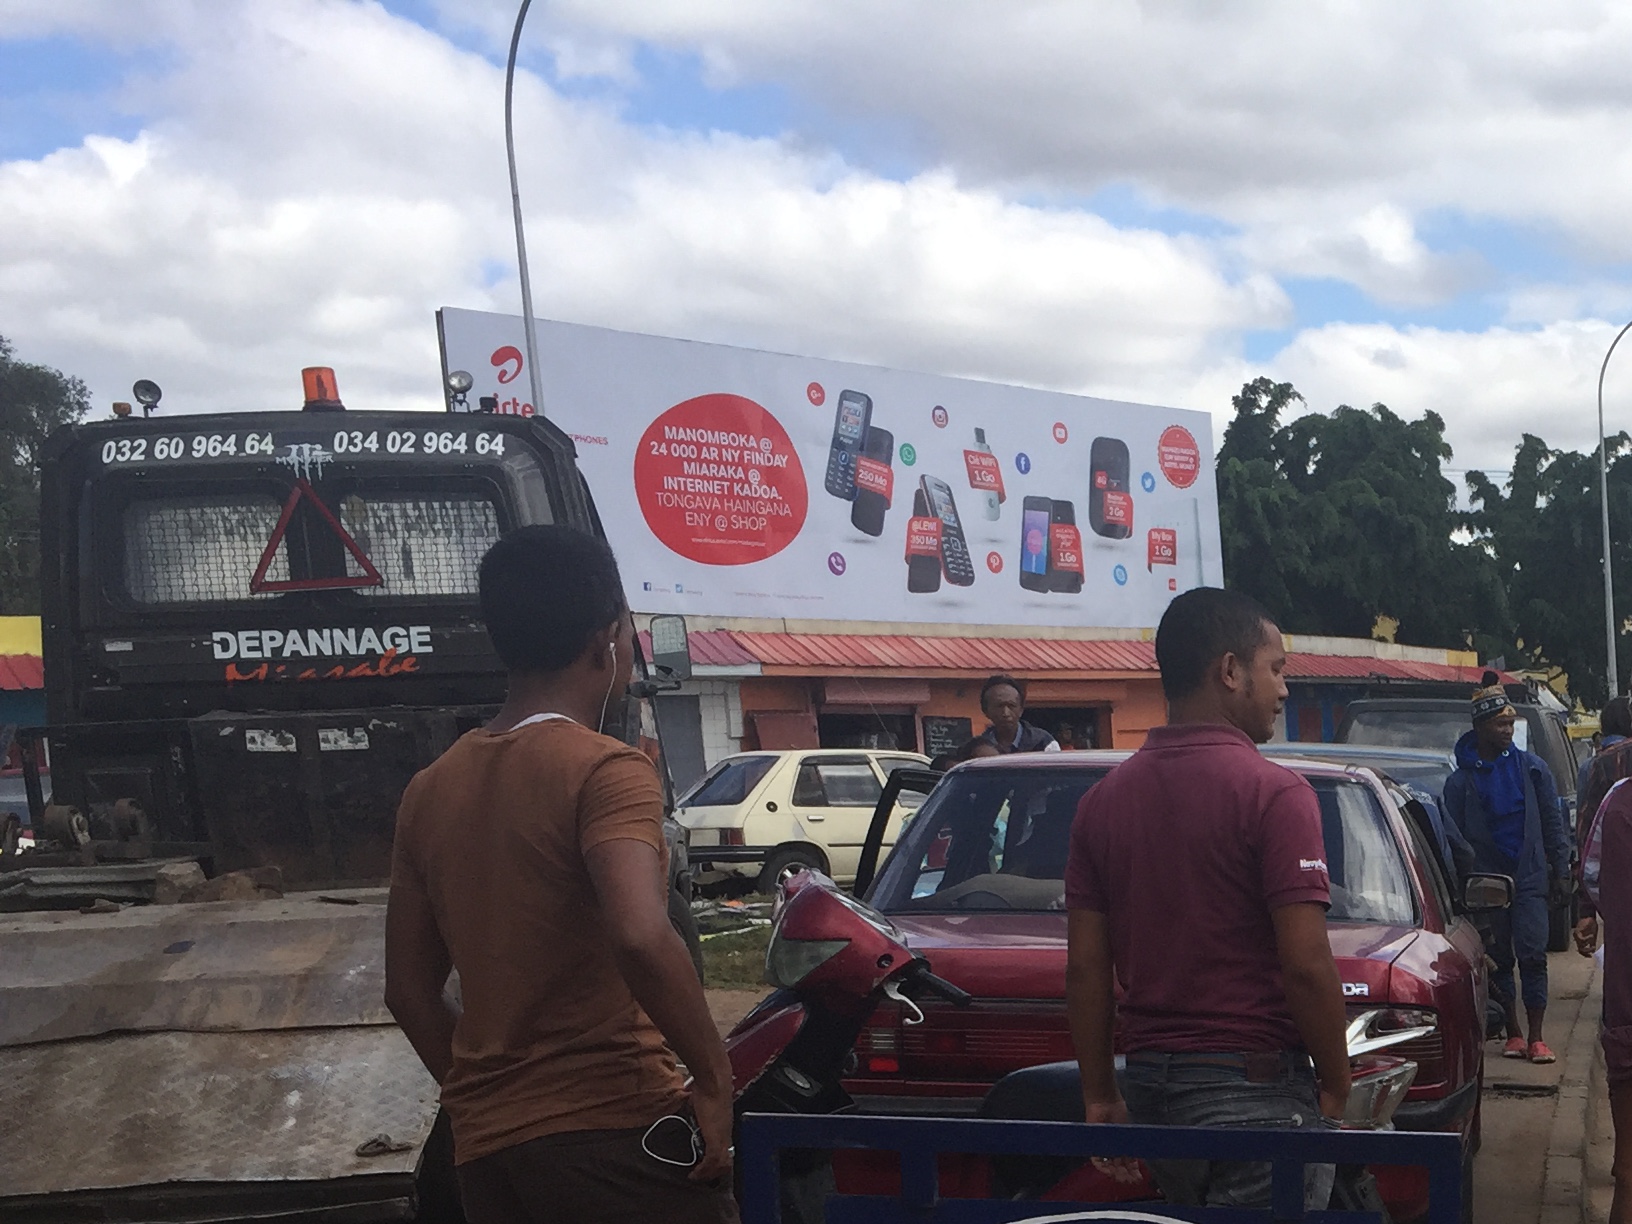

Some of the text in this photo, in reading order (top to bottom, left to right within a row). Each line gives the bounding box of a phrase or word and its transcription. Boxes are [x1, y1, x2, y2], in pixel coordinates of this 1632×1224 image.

[102, 432, 275, 464] 032 60 964 64
[333, 431, 505, 456] 034 02 964 64
[664, 425, 772, 453] MANOMBOKA @
[650, 441, 789, 468] 24 000 AR NY FINDAY
[683, 461, 760, 484] MIARAKA @
[981, 470, 996, 483] Go
[663, 476, 783, 500] INTERNET KADOA.
[656, 492, 792, 517] TONGAVA HAINGANA
[685, 512, 767, 532] ENY @ SHOP
[1065, 552, 1077, 563] Go
[1160, 545, 1172, 557] Go
[211, 625, 434, 660] DEPANNAGE
